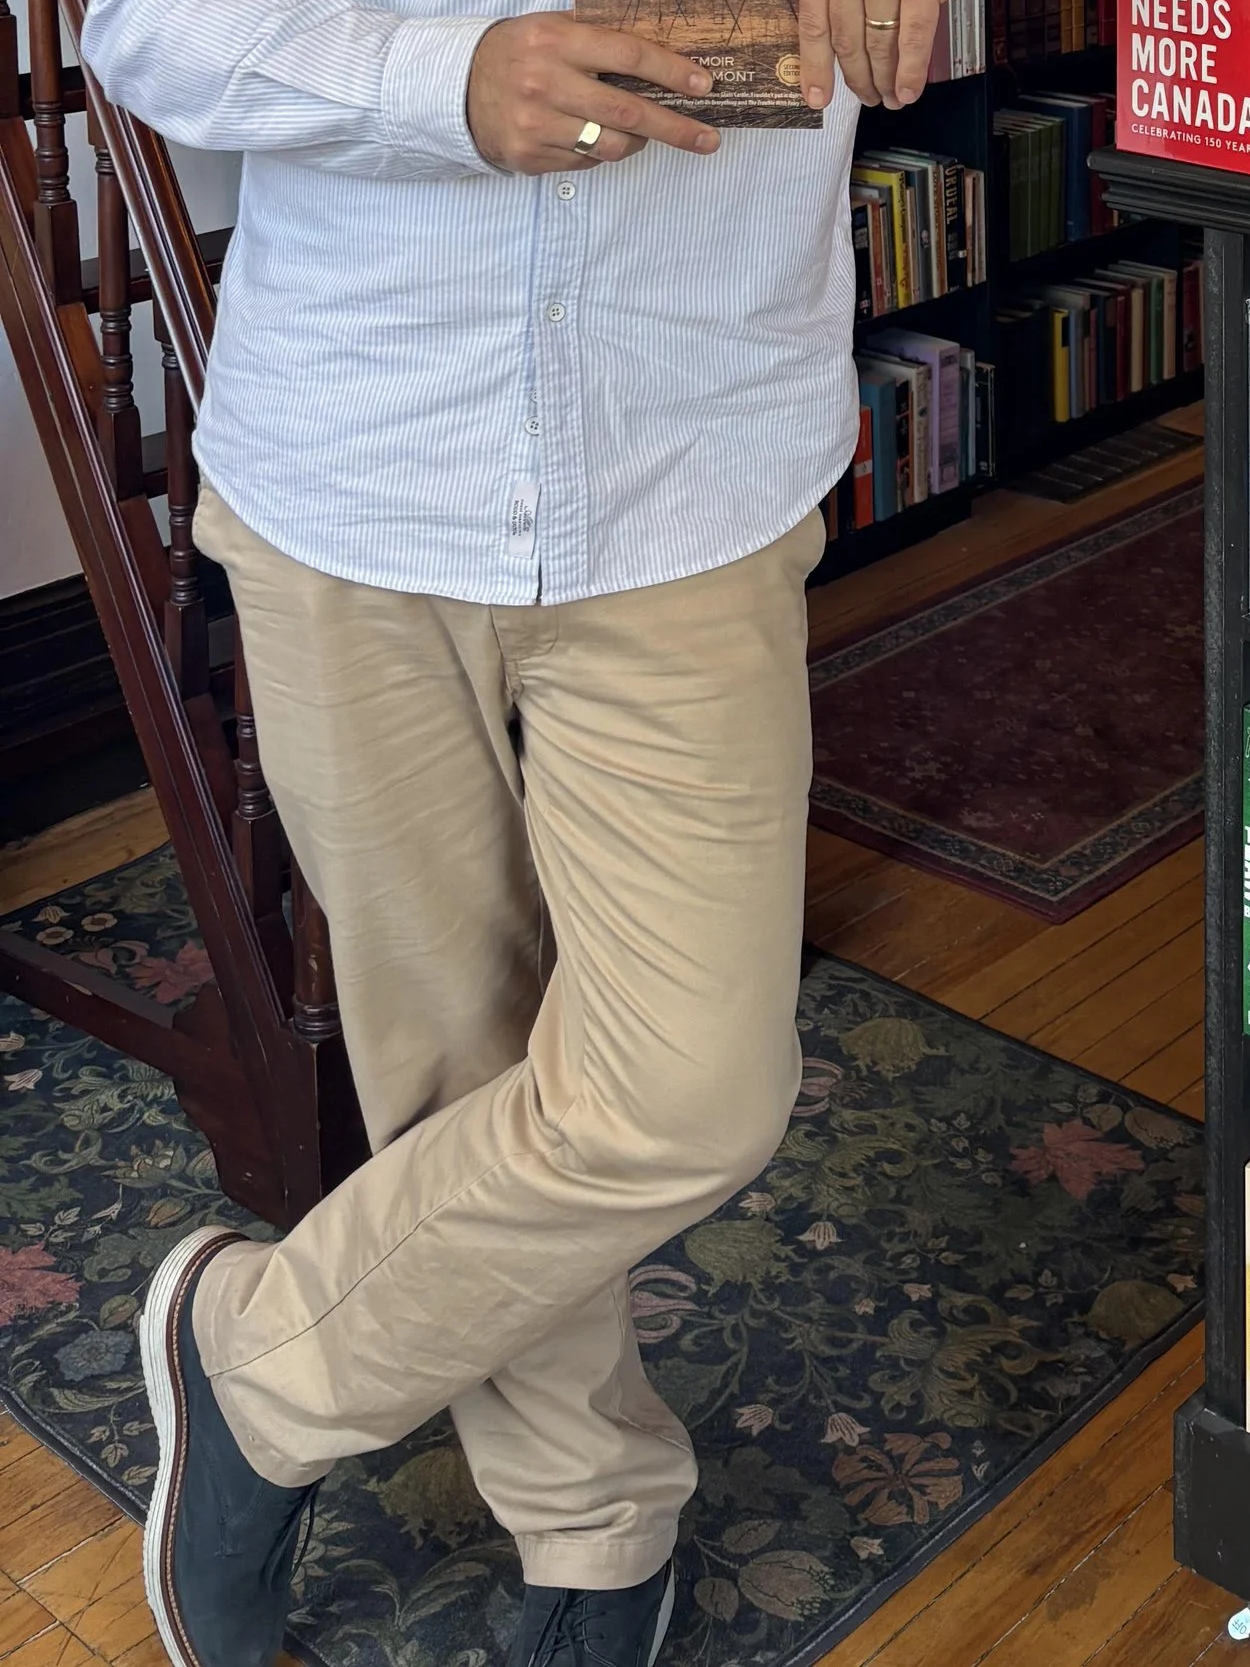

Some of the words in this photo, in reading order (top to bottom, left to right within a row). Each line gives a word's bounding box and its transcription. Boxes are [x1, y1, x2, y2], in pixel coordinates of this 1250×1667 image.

[1131, 33, 1218, 84] MORE
[1132, 123, 1202, 146] CELEBRATING
[1204, 135, 1222, 148] 150
